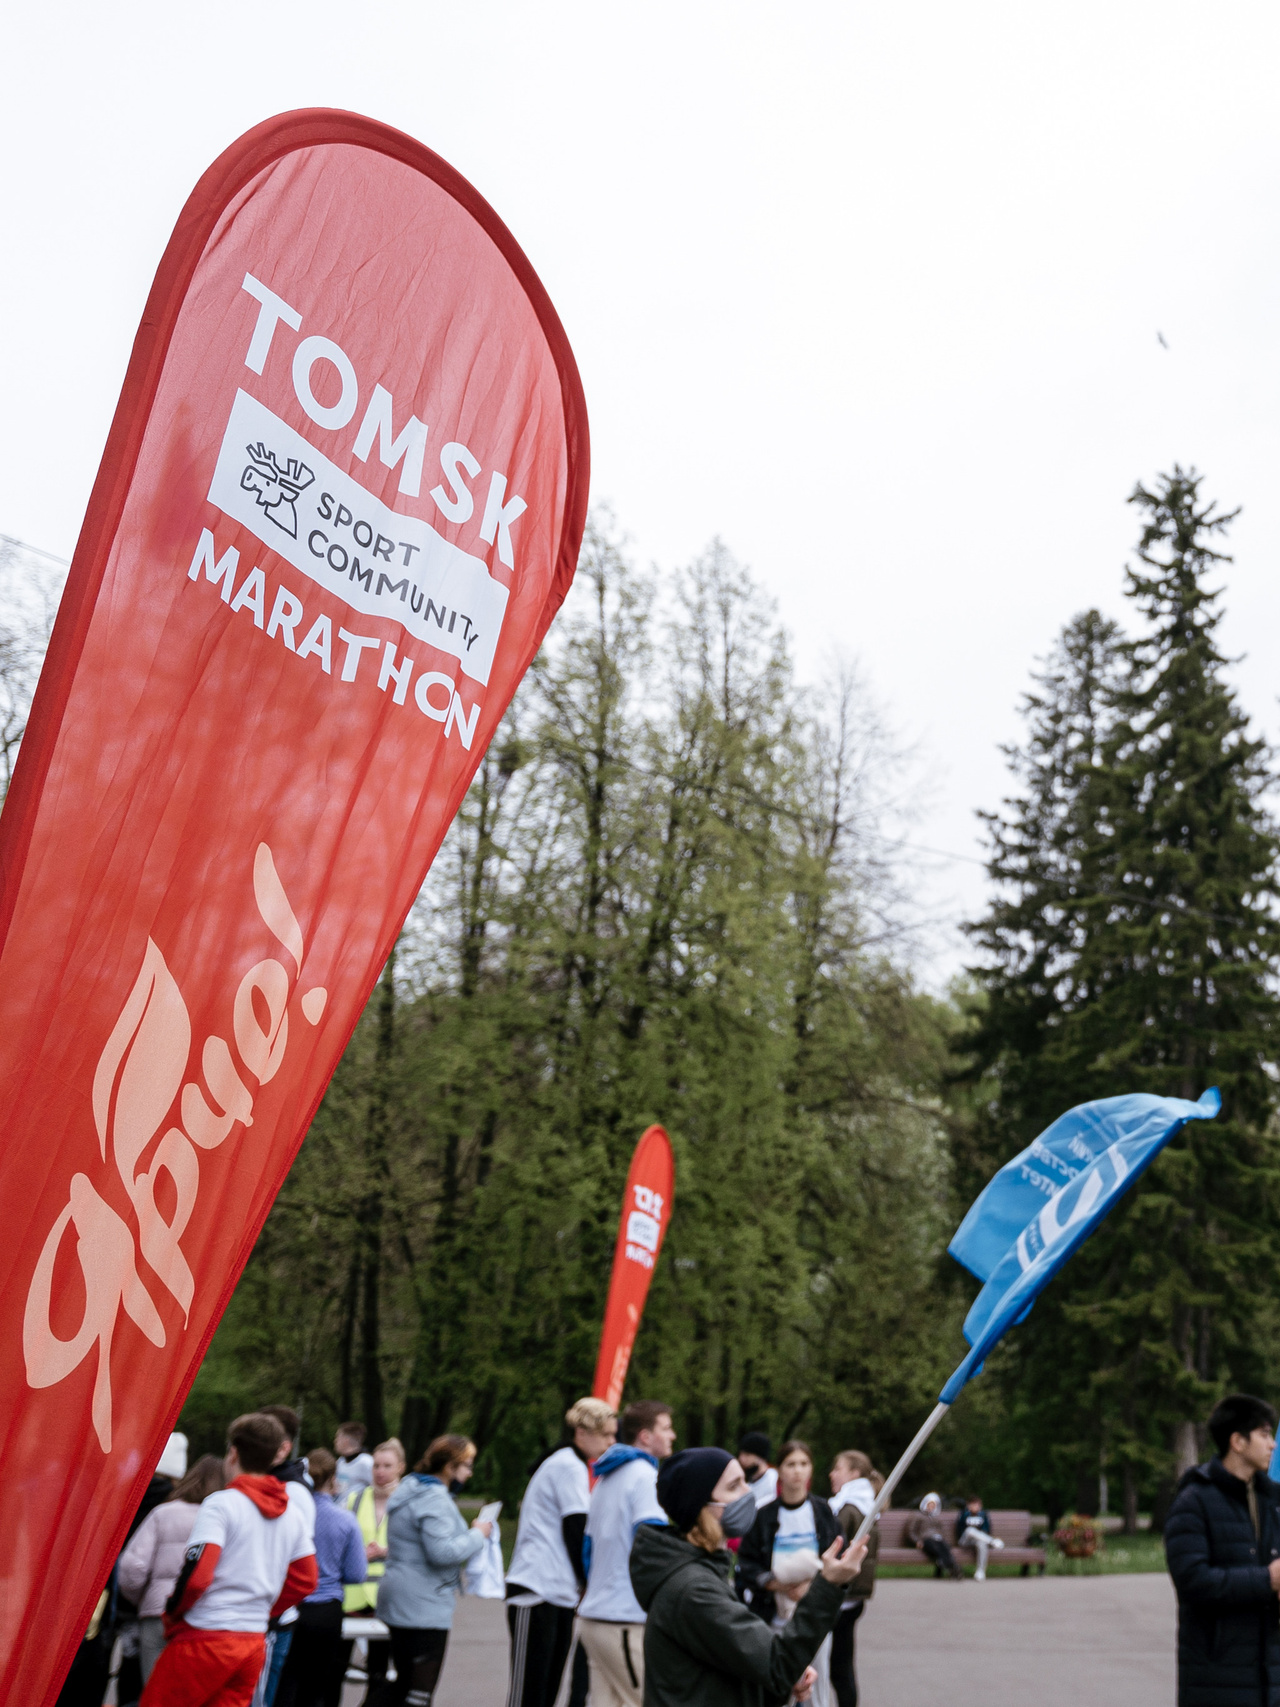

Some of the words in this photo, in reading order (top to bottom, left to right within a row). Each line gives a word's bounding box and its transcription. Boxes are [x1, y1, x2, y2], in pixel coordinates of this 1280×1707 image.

[242, 272, 527, 571] TOMSK
[308, 529, 479, 652] COMMUNITY
[316, 492, 421, 567] SPORT
[187, 527, 481, 751] MARATHON
